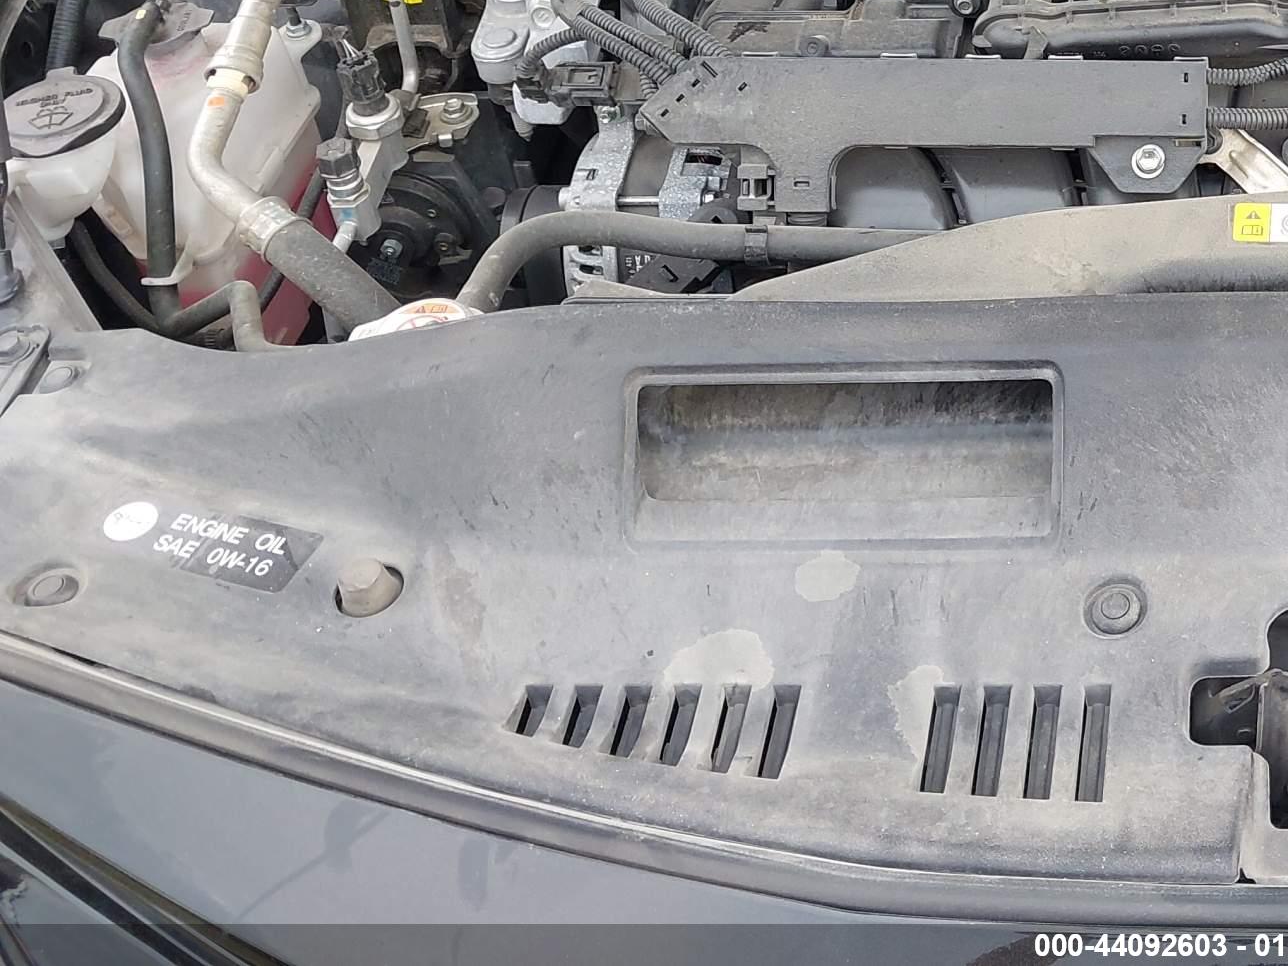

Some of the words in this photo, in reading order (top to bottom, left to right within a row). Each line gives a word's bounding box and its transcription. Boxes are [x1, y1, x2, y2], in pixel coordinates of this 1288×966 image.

[153, 534, 200, 558] SAE
[206, 547, 273, 576] 0W-16
[170, 513, 249, 545] ENGINE
[254, 533, 287, 555] OIL
